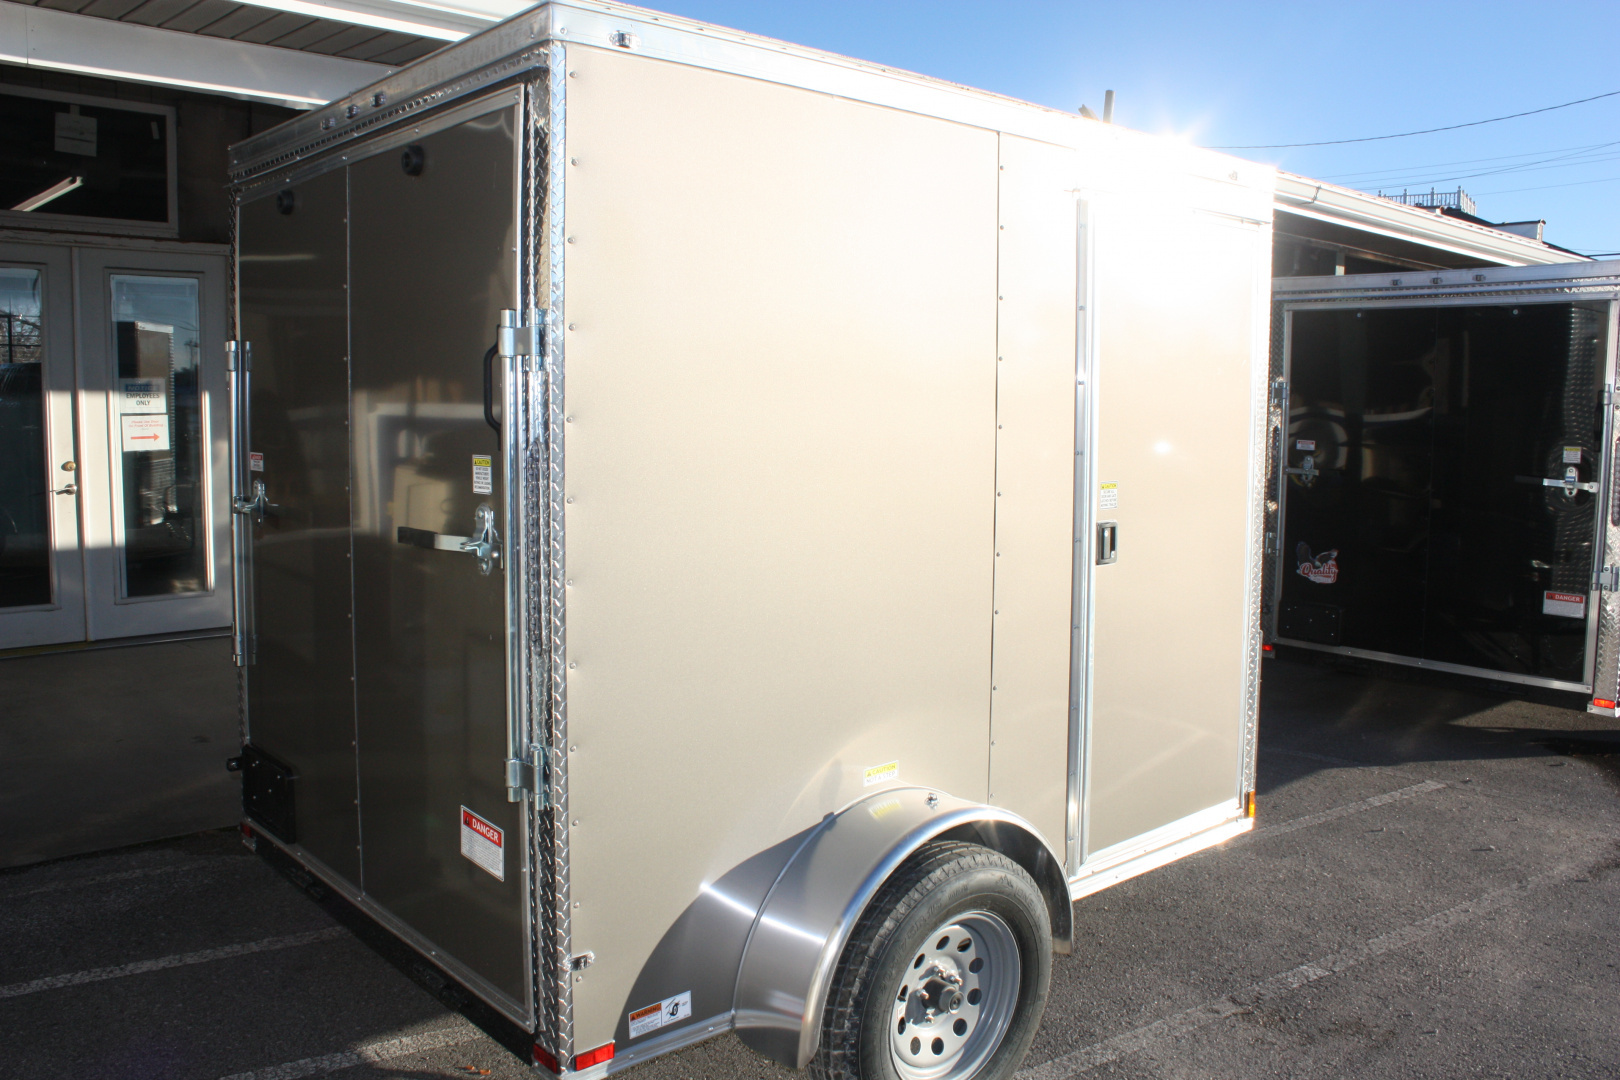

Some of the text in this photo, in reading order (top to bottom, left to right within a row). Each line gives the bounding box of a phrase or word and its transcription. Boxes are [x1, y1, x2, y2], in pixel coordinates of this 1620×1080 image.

[1300, 562, 1338, 583] Quality
[1555, 594, 1581, 602] DANGER
[866, 775, 877, 783] NOT
[883, 770, 896, 779] STEP
[872, 764, 896, 775] CAUTION
[472, 818, 499, 843] DANGER
[636, 1003, 661, 1018] WARNING
